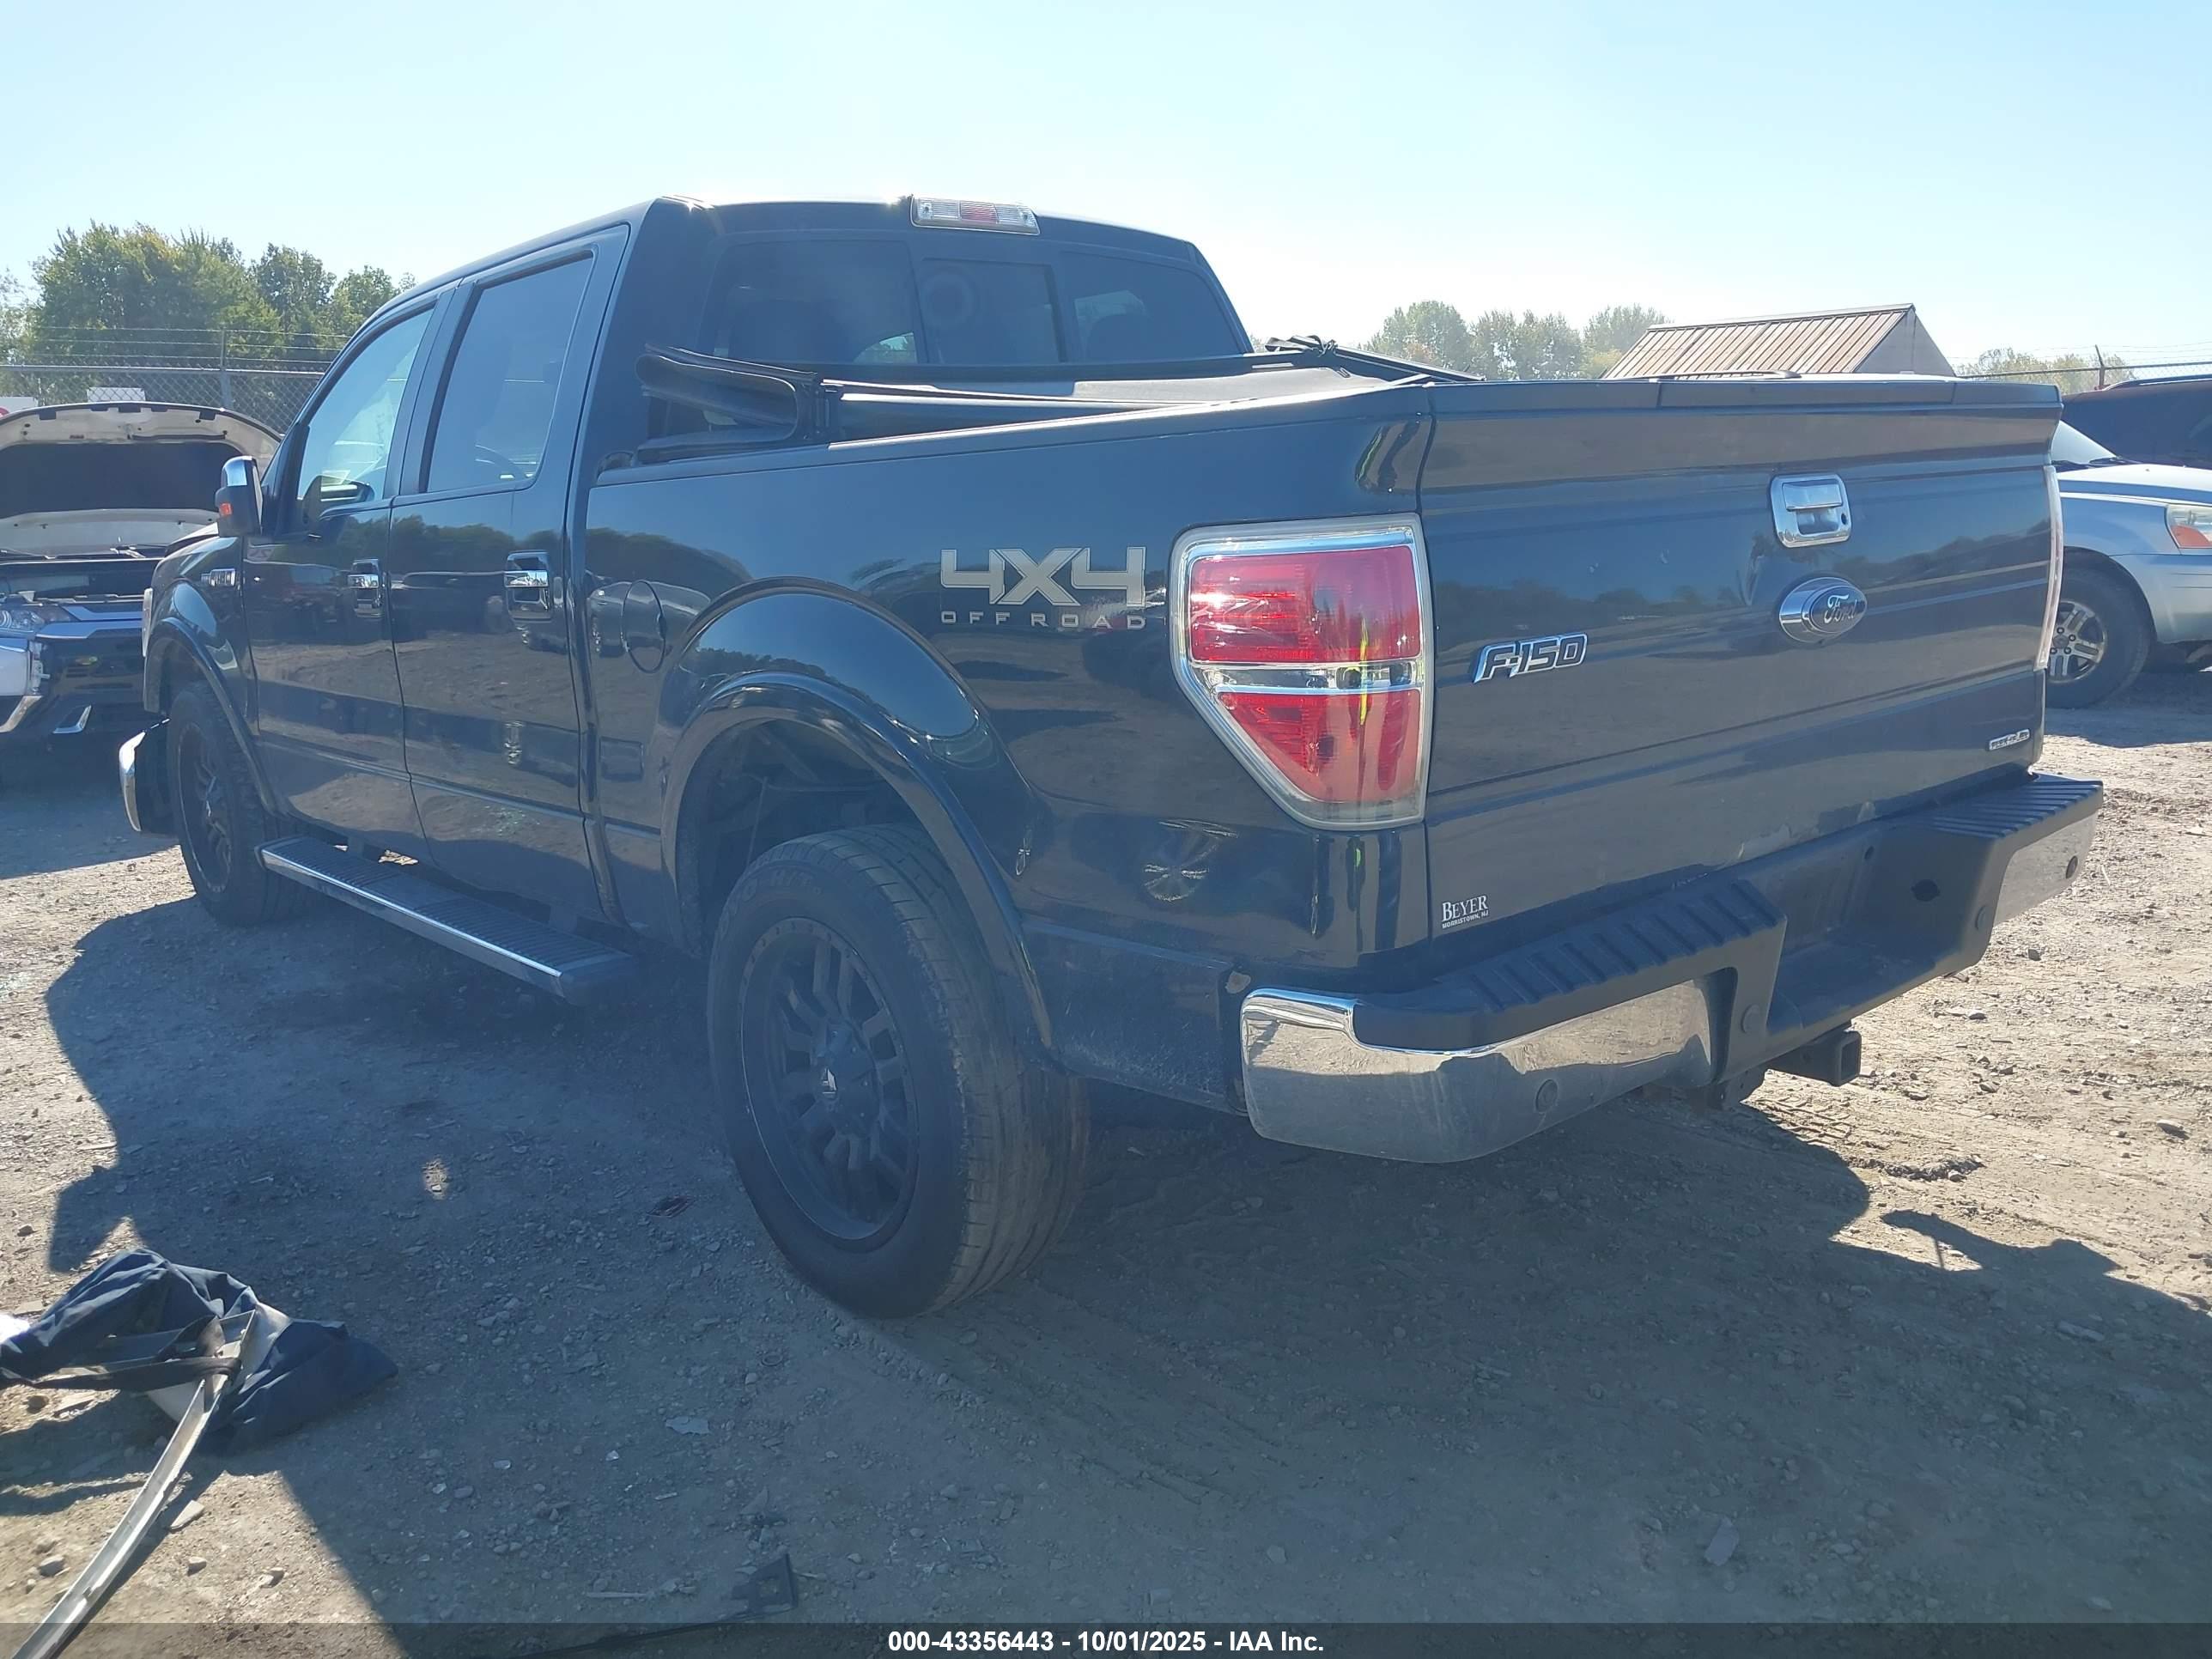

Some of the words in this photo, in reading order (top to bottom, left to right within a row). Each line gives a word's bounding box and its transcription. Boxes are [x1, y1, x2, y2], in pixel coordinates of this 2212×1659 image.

[940, 547, 1146, 606] 4X4
[941, 611, 1011, 625] OFF
[1030, 612, 1146, 630] ROAD
[1824, 593, 1858, 623] Ford
[1474, 634, 1588, 684] F-150
[1442, 895, 1489, 922] BEYER
